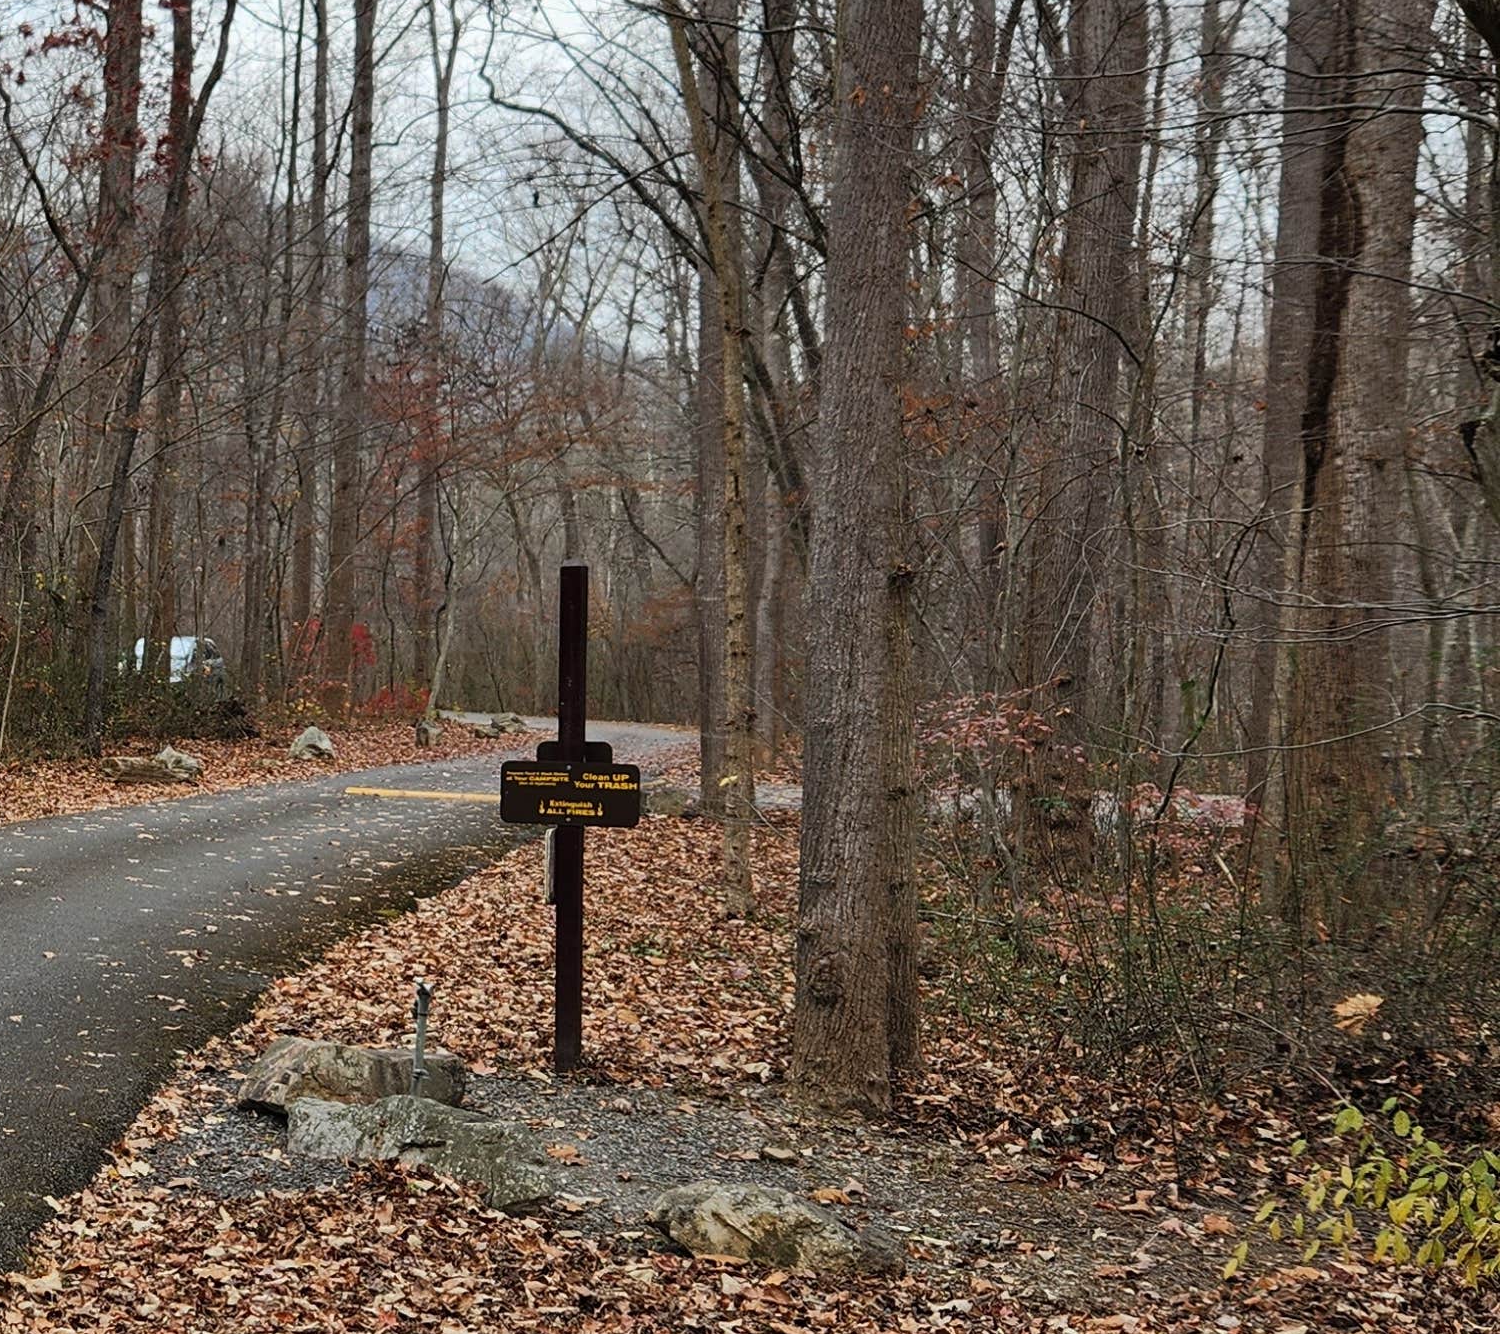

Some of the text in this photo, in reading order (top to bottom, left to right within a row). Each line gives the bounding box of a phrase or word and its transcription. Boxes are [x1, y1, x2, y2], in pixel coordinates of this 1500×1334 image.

[582, 772, 630, 782] Clean UP
[573, 780, 638, 790] Your TRASH
[549, 799, 593, 809] Extinguish
[566, 808, 596, 816] FIRES
